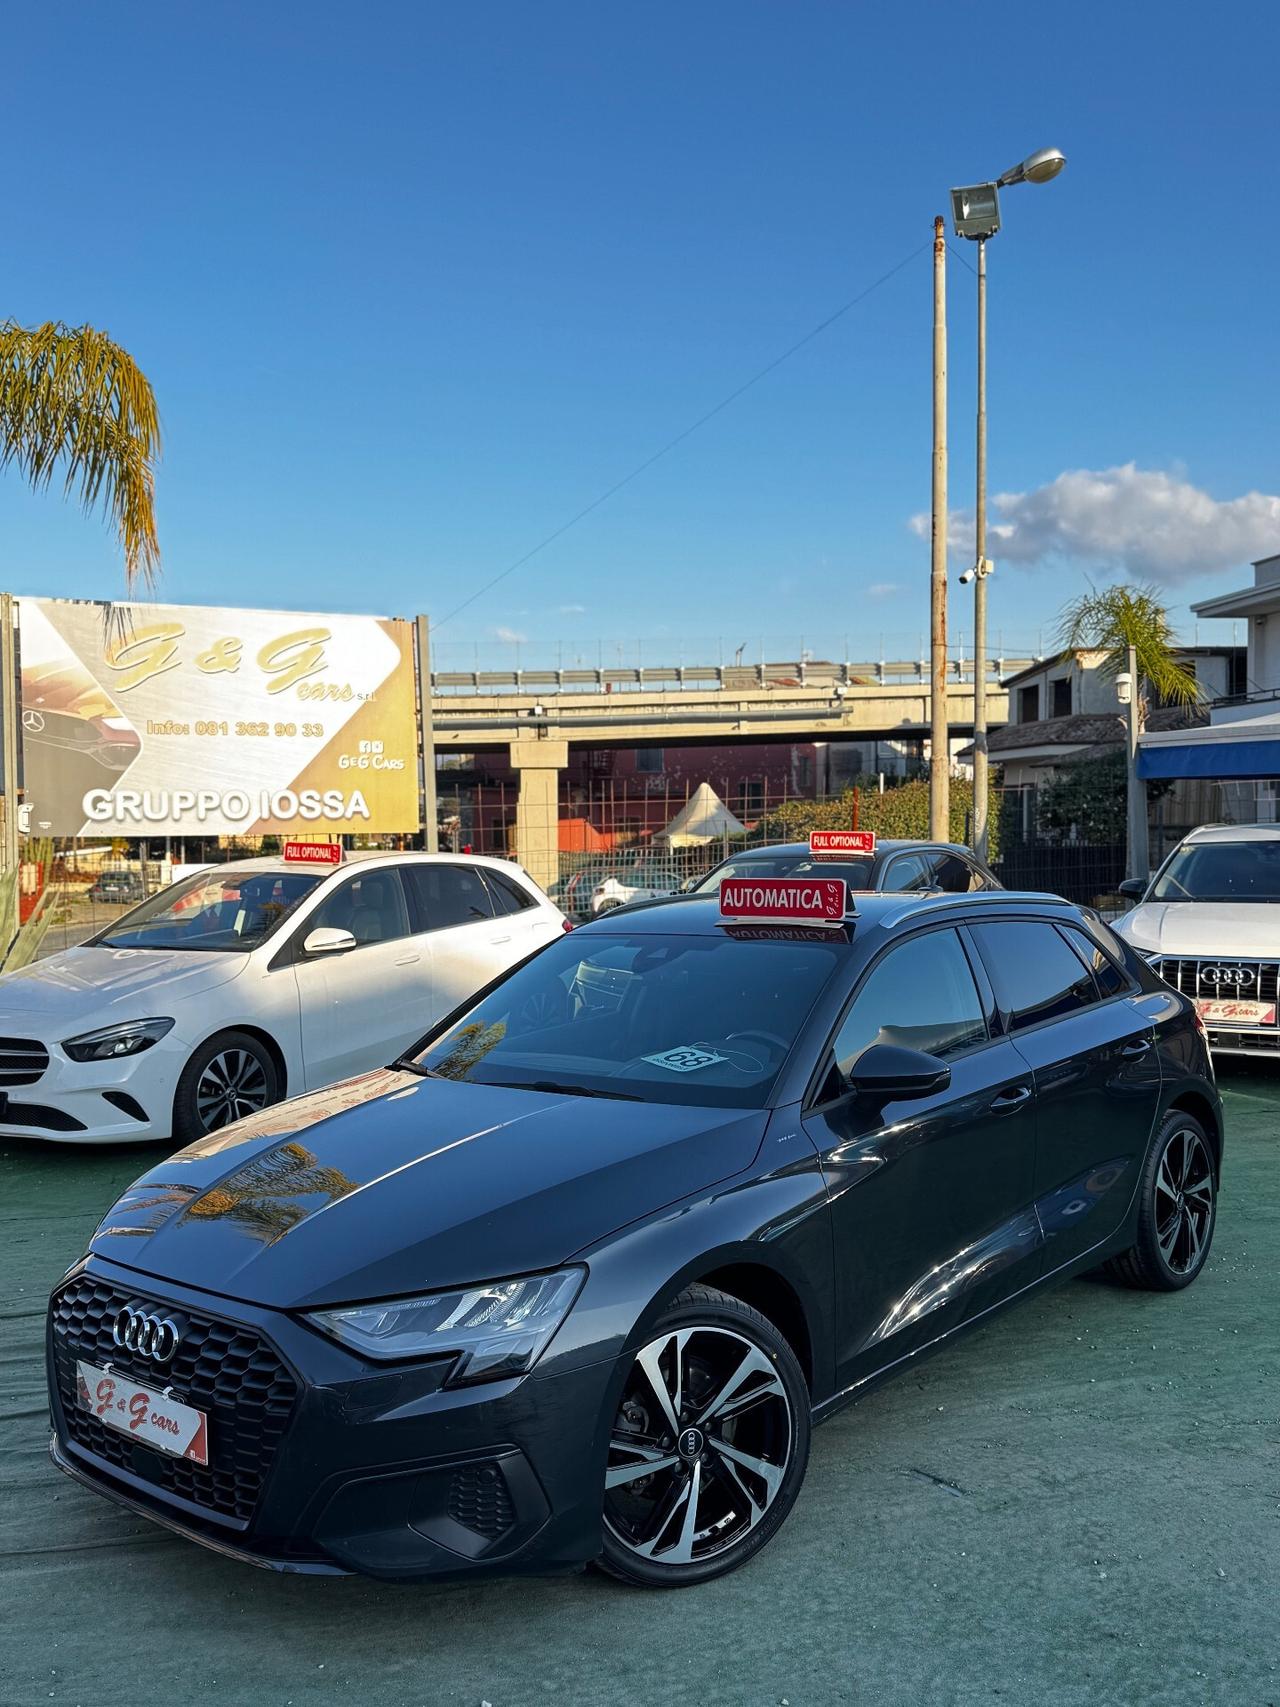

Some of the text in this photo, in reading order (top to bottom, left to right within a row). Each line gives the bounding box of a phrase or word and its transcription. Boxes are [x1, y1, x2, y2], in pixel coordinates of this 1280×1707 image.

[104, 622, 332, 696] G & G
[296, 682, 356, 702] cars
[146, 719, 325, 738] Info: 081 362 90 33
[82, 789, 371, 821] GRUPPO IOSSA
[814, 836, 828, 846] FULL
[829, 836, 864, 847] OPTIONAL
[286, 846, 300, 858] FULL
[301, 846, 332, 859] OPTIONAL
[723, 887, 823, 910] AUTOMATICA
[664, 1051, 712, 1067] 68
[96, 1378, 116, 1415] G
[129, 1392, 150, 1430] G
[150, 1412, 181, 1436] cars
